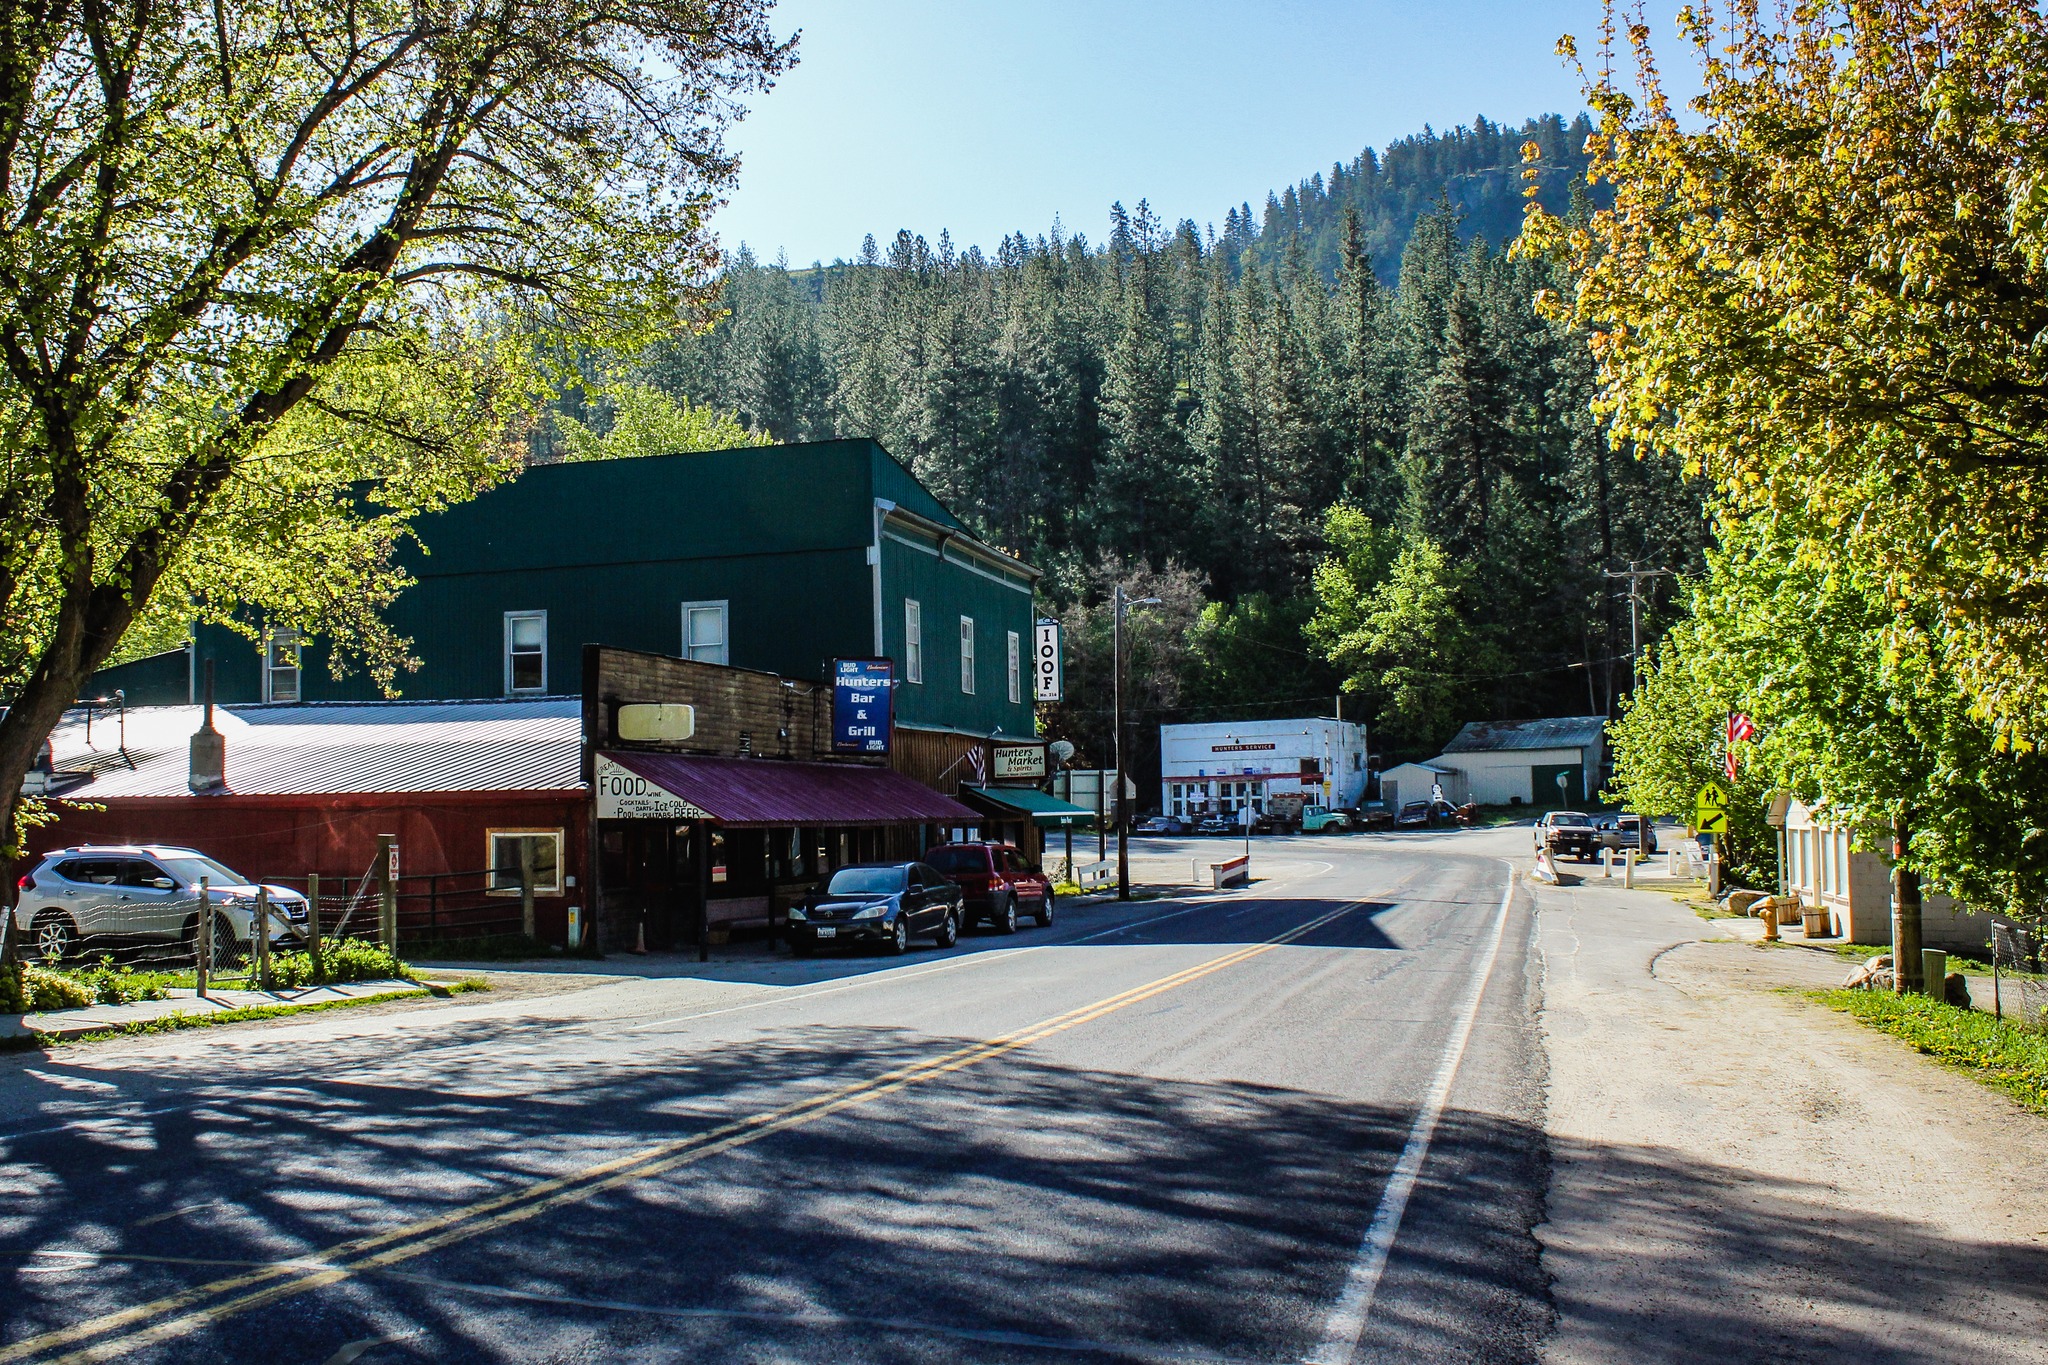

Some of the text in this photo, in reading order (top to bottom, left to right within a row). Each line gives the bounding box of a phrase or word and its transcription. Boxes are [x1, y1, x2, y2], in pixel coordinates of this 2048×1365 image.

[1041, 629, 1054, 690] IOOF
[836, 677, 891, 687] Hunters
[851, 693, 875, 703] Bar
[856, 709, 867, 720] &
[848, 726, 875, 736] Grill
[995, 748, 1034, 758] Hunters
[1008, 756, 1043, 765] Market
[597, 761, 615, 775] GREAT
[600, 776, 647, 796] FOOD
[669, 800, 688, 808] COLD
[674, 808, 700, 818] BEER
